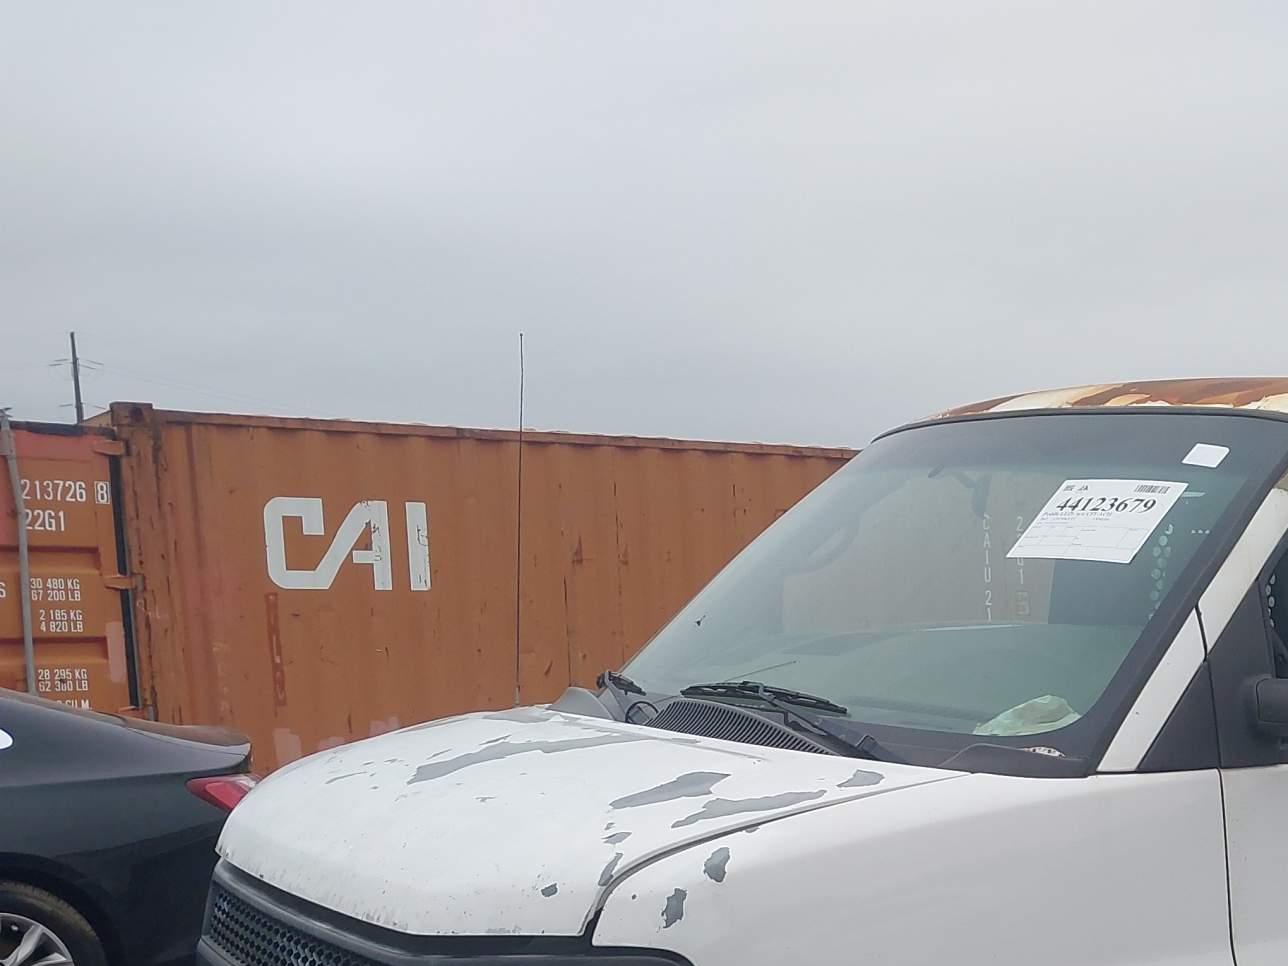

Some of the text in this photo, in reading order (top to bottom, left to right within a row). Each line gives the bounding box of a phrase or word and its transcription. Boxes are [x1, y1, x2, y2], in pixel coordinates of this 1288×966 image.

[20, 479, 109, 504] 213726 8
[1056, 496, 1157, 513] 44123679
[24, 508, 65, 531] 22G1
[264, 497, 431, 591] CAI
[46, 578, 65, 589] 480
[67, 578, 80, 590] KG
[31, 590, 81, 602] 67 200 LB
[39, 609, 46, 621] 2
[70, 609, 83, 621] KG
[40, 621, 46, 633] 4
[71, 621, 84, 633] LB
[38, 668, 88, 680] 28 295 KG
[38, 681, 51, 692] 62
[76, 680, 89, 692] LB
